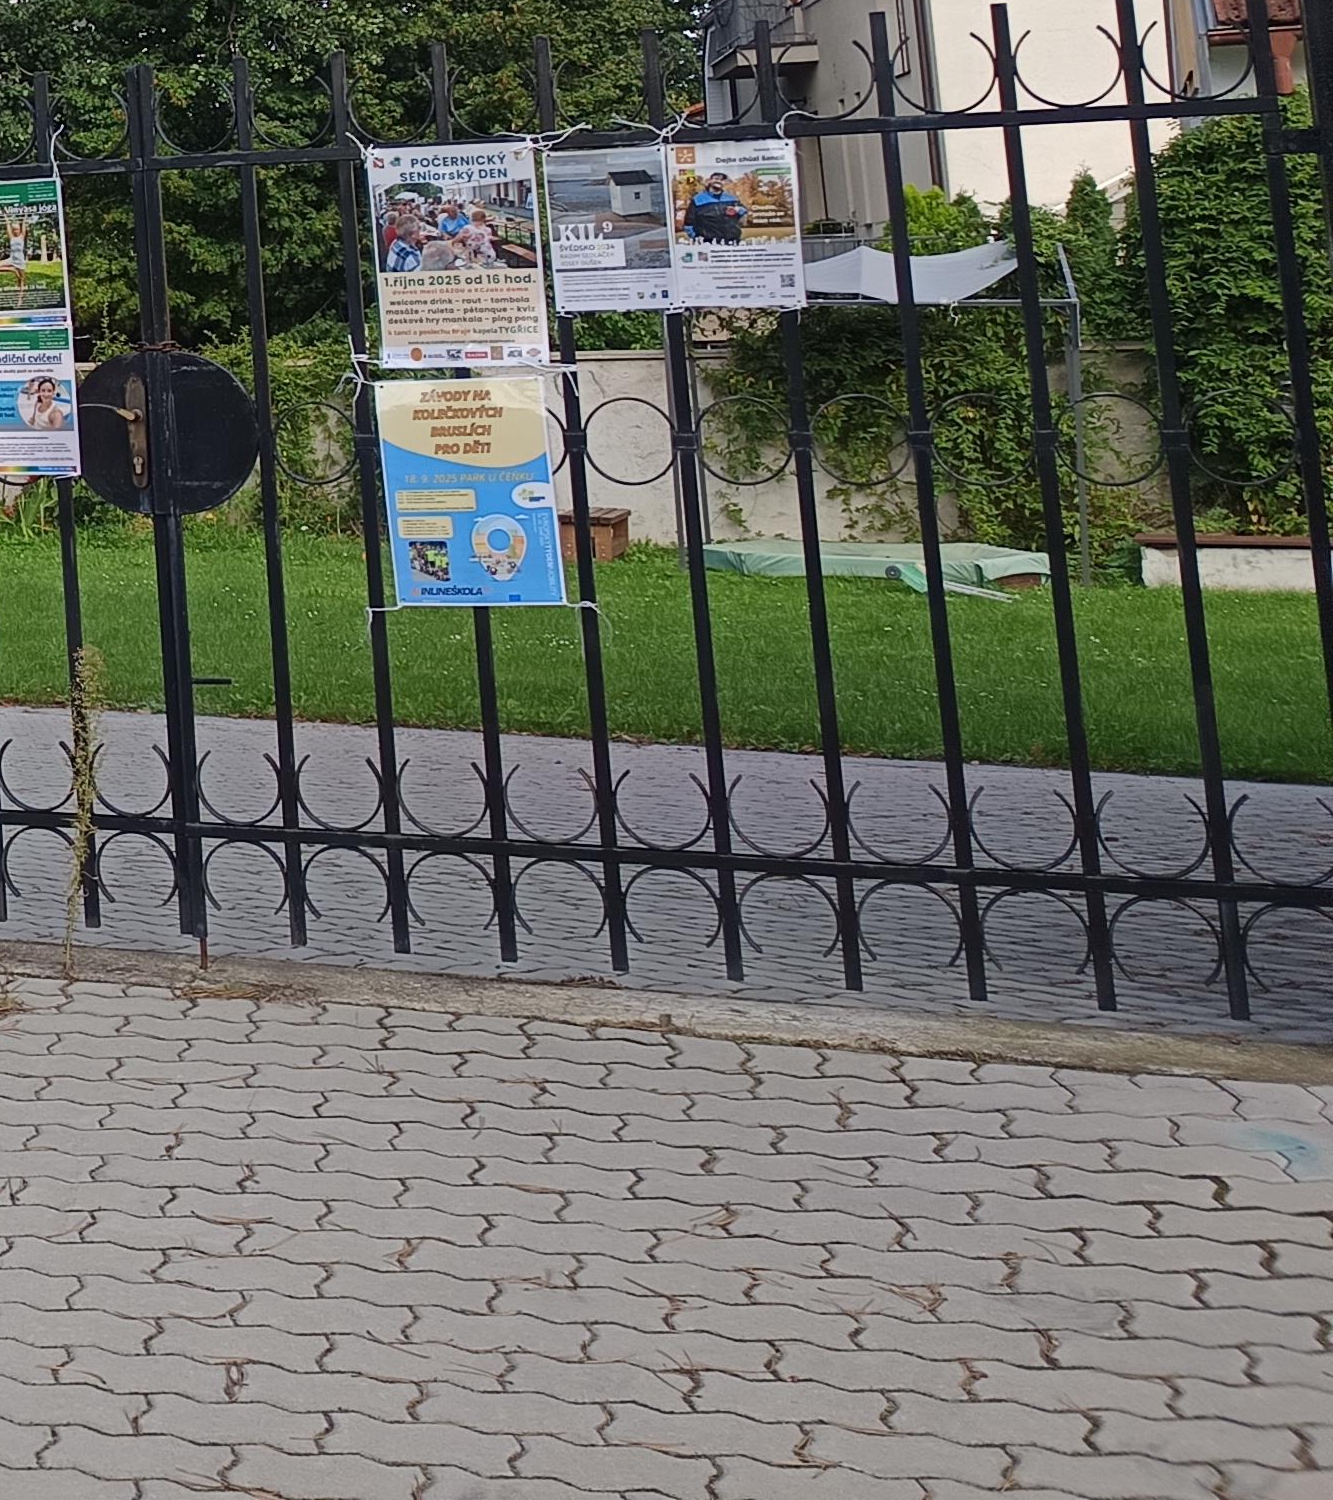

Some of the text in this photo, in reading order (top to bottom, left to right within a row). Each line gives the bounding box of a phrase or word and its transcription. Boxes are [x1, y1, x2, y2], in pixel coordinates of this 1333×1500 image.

[410, 152, 507, 168] POČERNICKÝ
[400, 168, 508, 183] SENiorský DEN
[429, 275, 461, 286] 2025
[465, 274, 483, 285] od
[486, 274, 501, 285] 16
[504, 273, 537, 284] hod.
[426, 317, 440, 325] hry
[492, 315, 512, 323] ping
[28, 352, 62, 362] cvičení
[420, 389, 492, 403] ZÁVODY NA
[412, 404, 504, 421] KOLEČKOVÝCH
[430, 423, 492, 438] BRUSLÍCH
[434, 440, 492, 455] PRO DĚTI
[460, 472, 486, 483] PARK
[420, 585, 484, 596] INLINEŠKOLA
